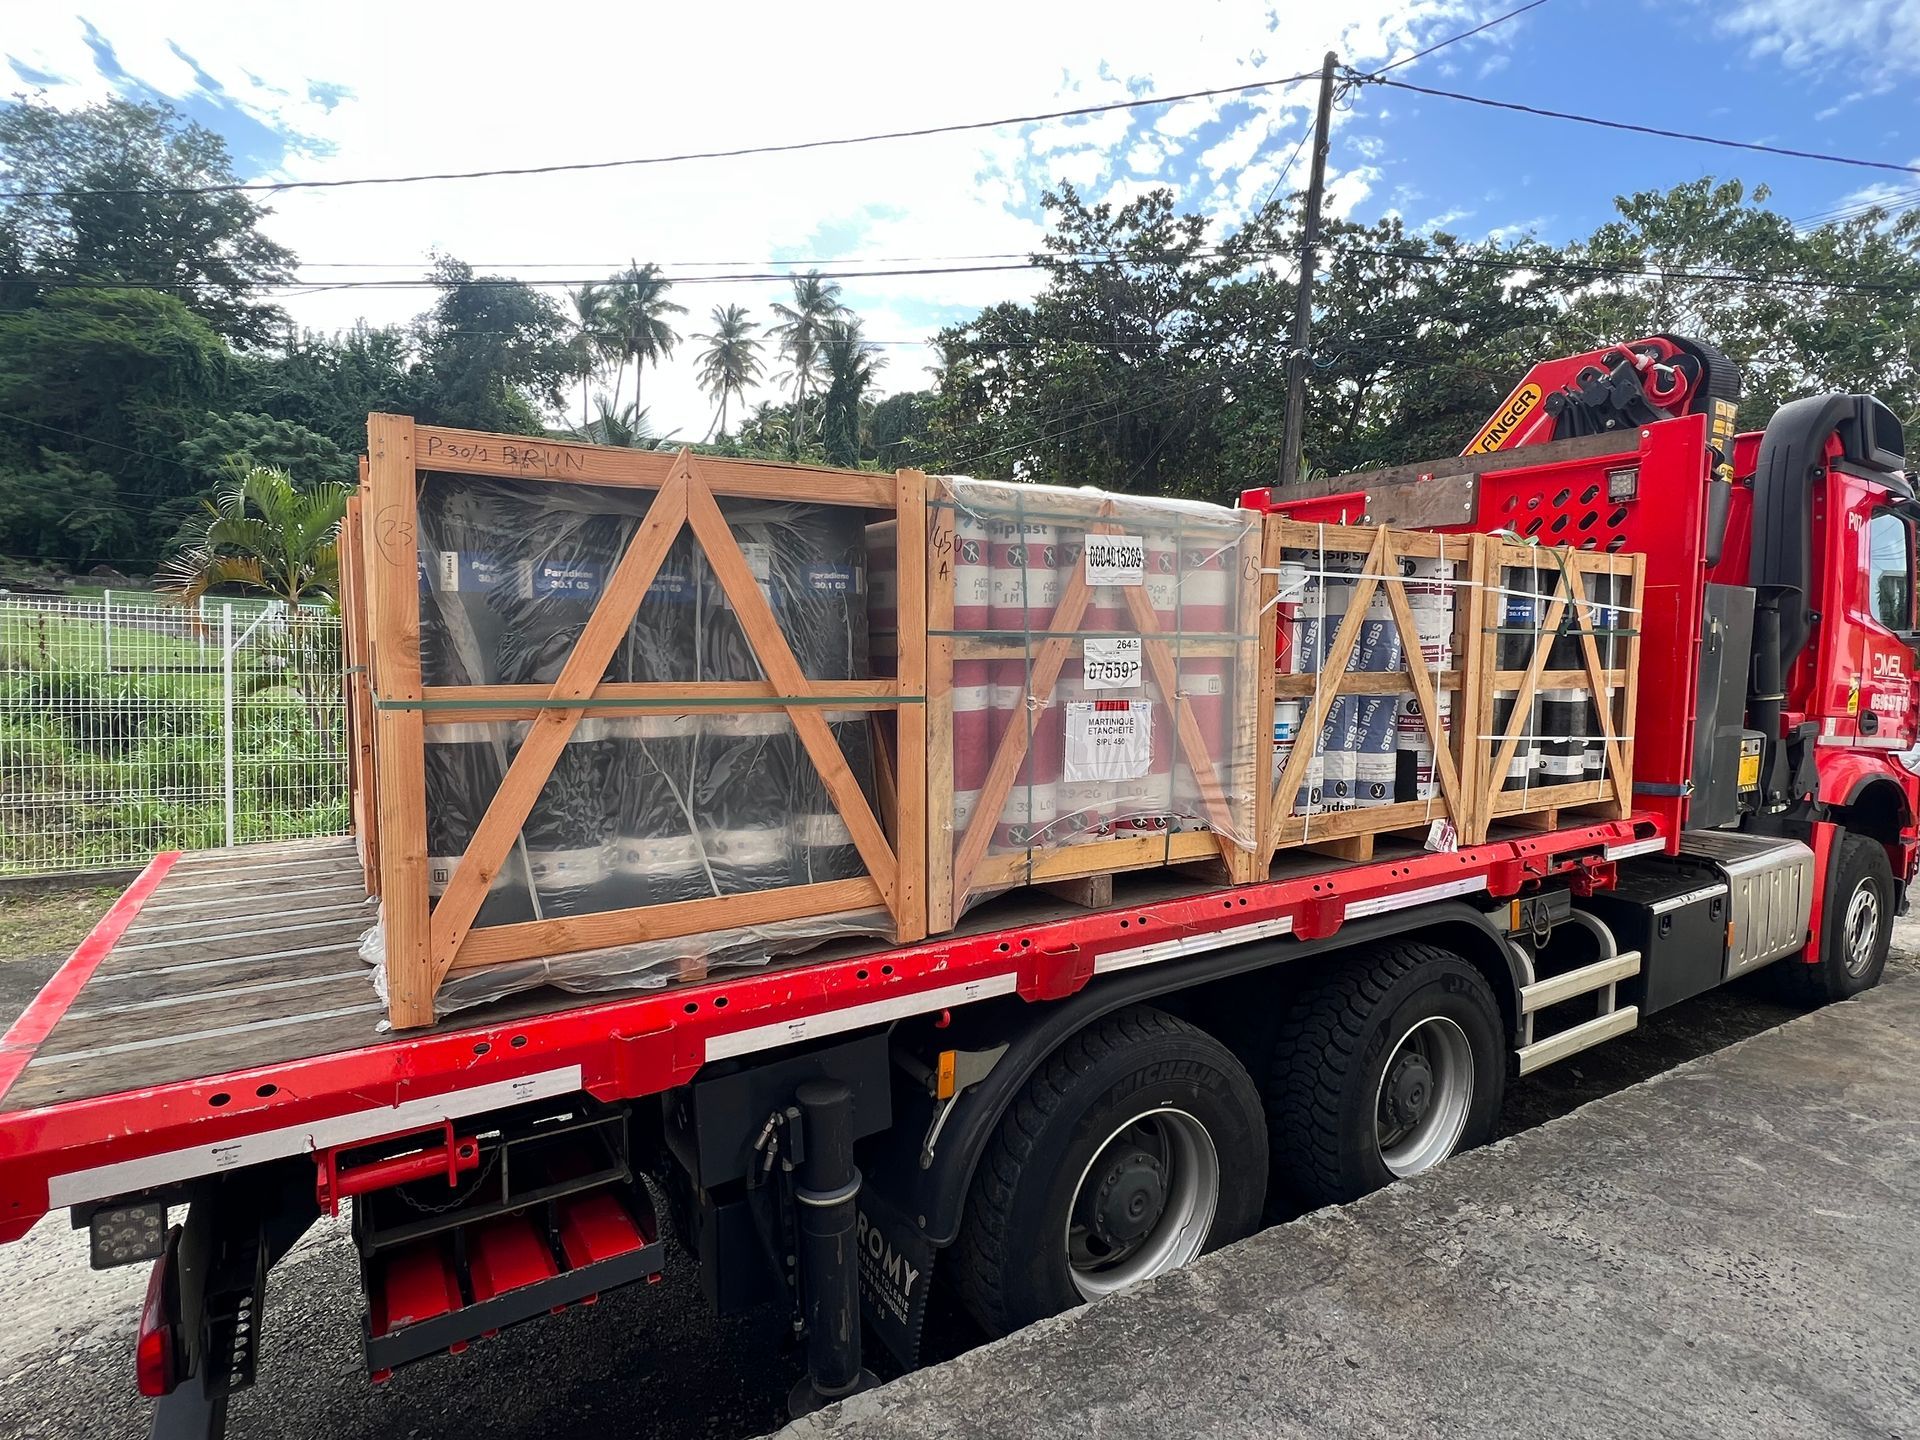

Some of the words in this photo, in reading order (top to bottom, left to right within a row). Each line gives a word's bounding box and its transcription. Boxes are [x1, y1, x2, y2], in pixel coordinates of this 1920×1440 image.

[1473, 390, 1537, 454] FINGER
[381, 519, 413, 547] 23
[933, 525, 963, 558] 450
[938, 560, 951, 581] A
[1116, 639, 1132, 650] 264
[1366, 623, 1383, 646] SBS
[1088, 661, 1139, 680] 07559P
[1088, 717, 1135, 726] MARTINIQUE
[1362, 699, 1381, 727] Veral
[1087, 726, 1135, 736] ETANCHEITE
[1111, 1059, 1225, 1109] MICHELIN
